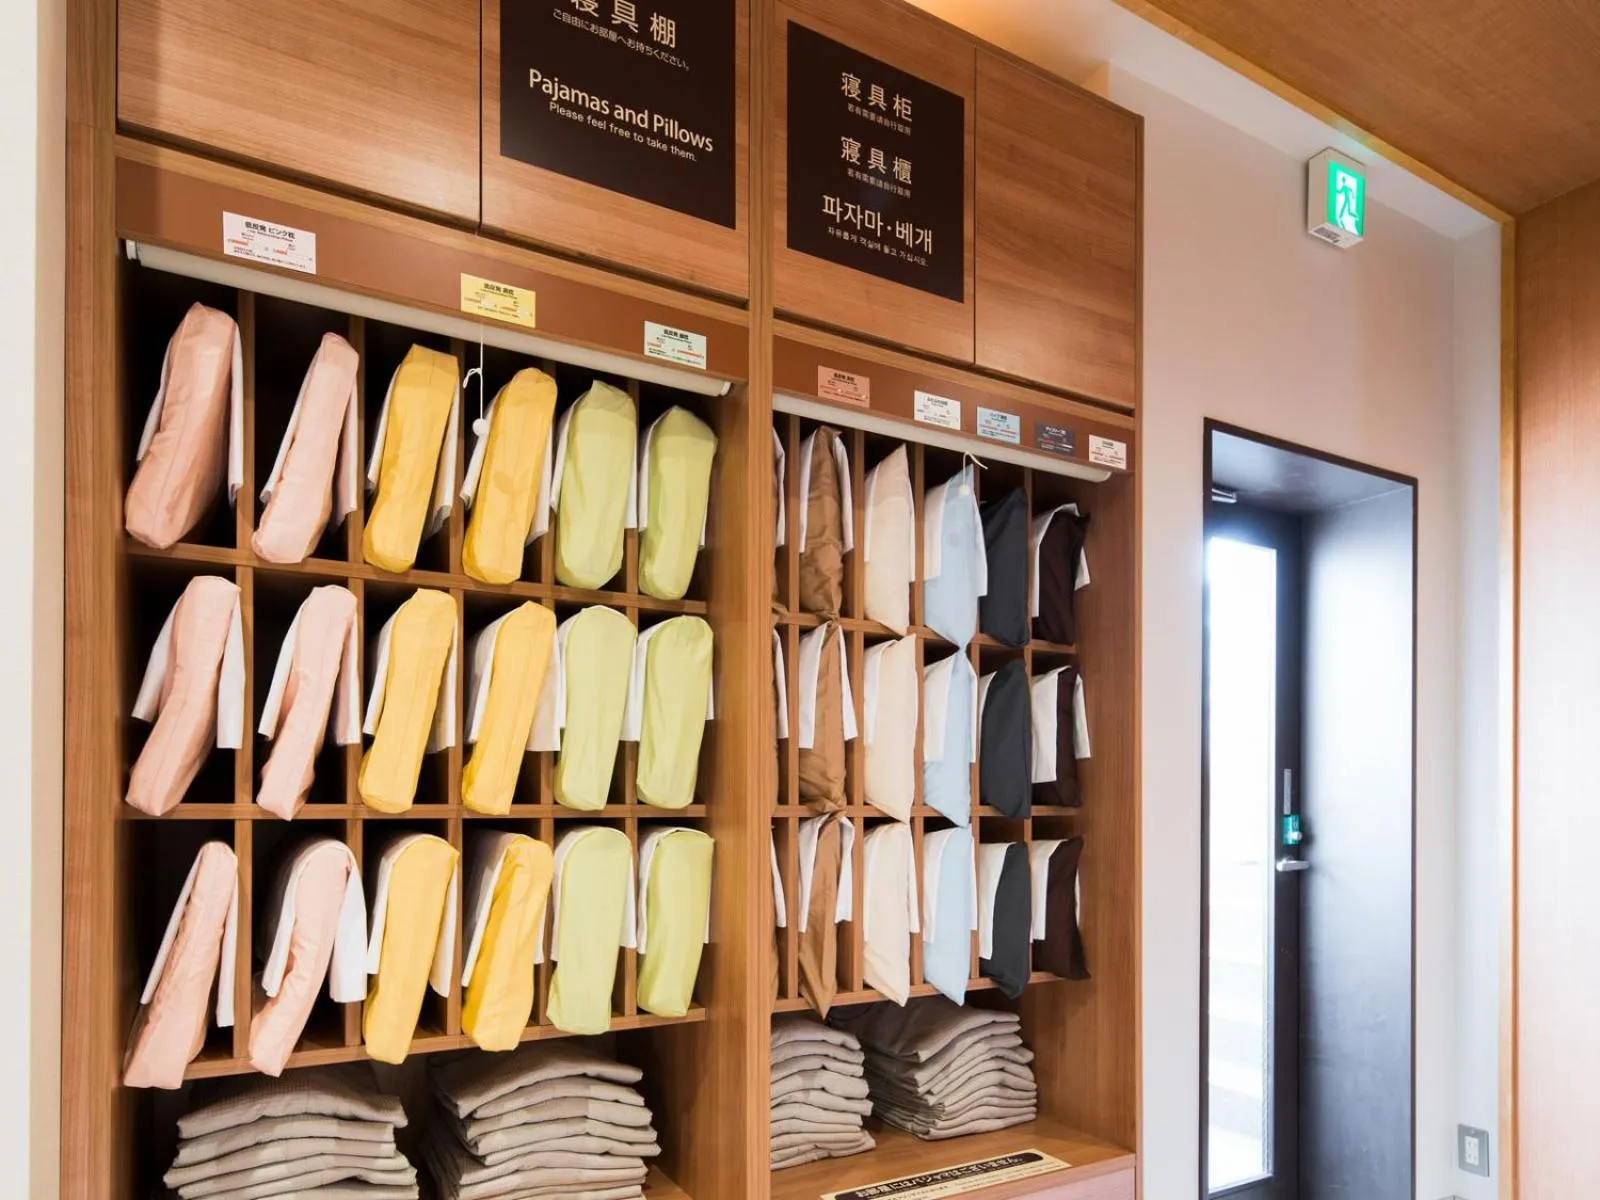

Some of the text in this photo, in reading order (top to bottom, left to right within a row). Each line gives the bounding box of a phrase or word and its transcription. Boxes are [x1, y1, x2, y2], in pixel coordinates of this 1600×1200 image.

[529, 68, 714, 152] Pajamas and Pillows
[549, 102, 697, 162] Please feel free to take them.
